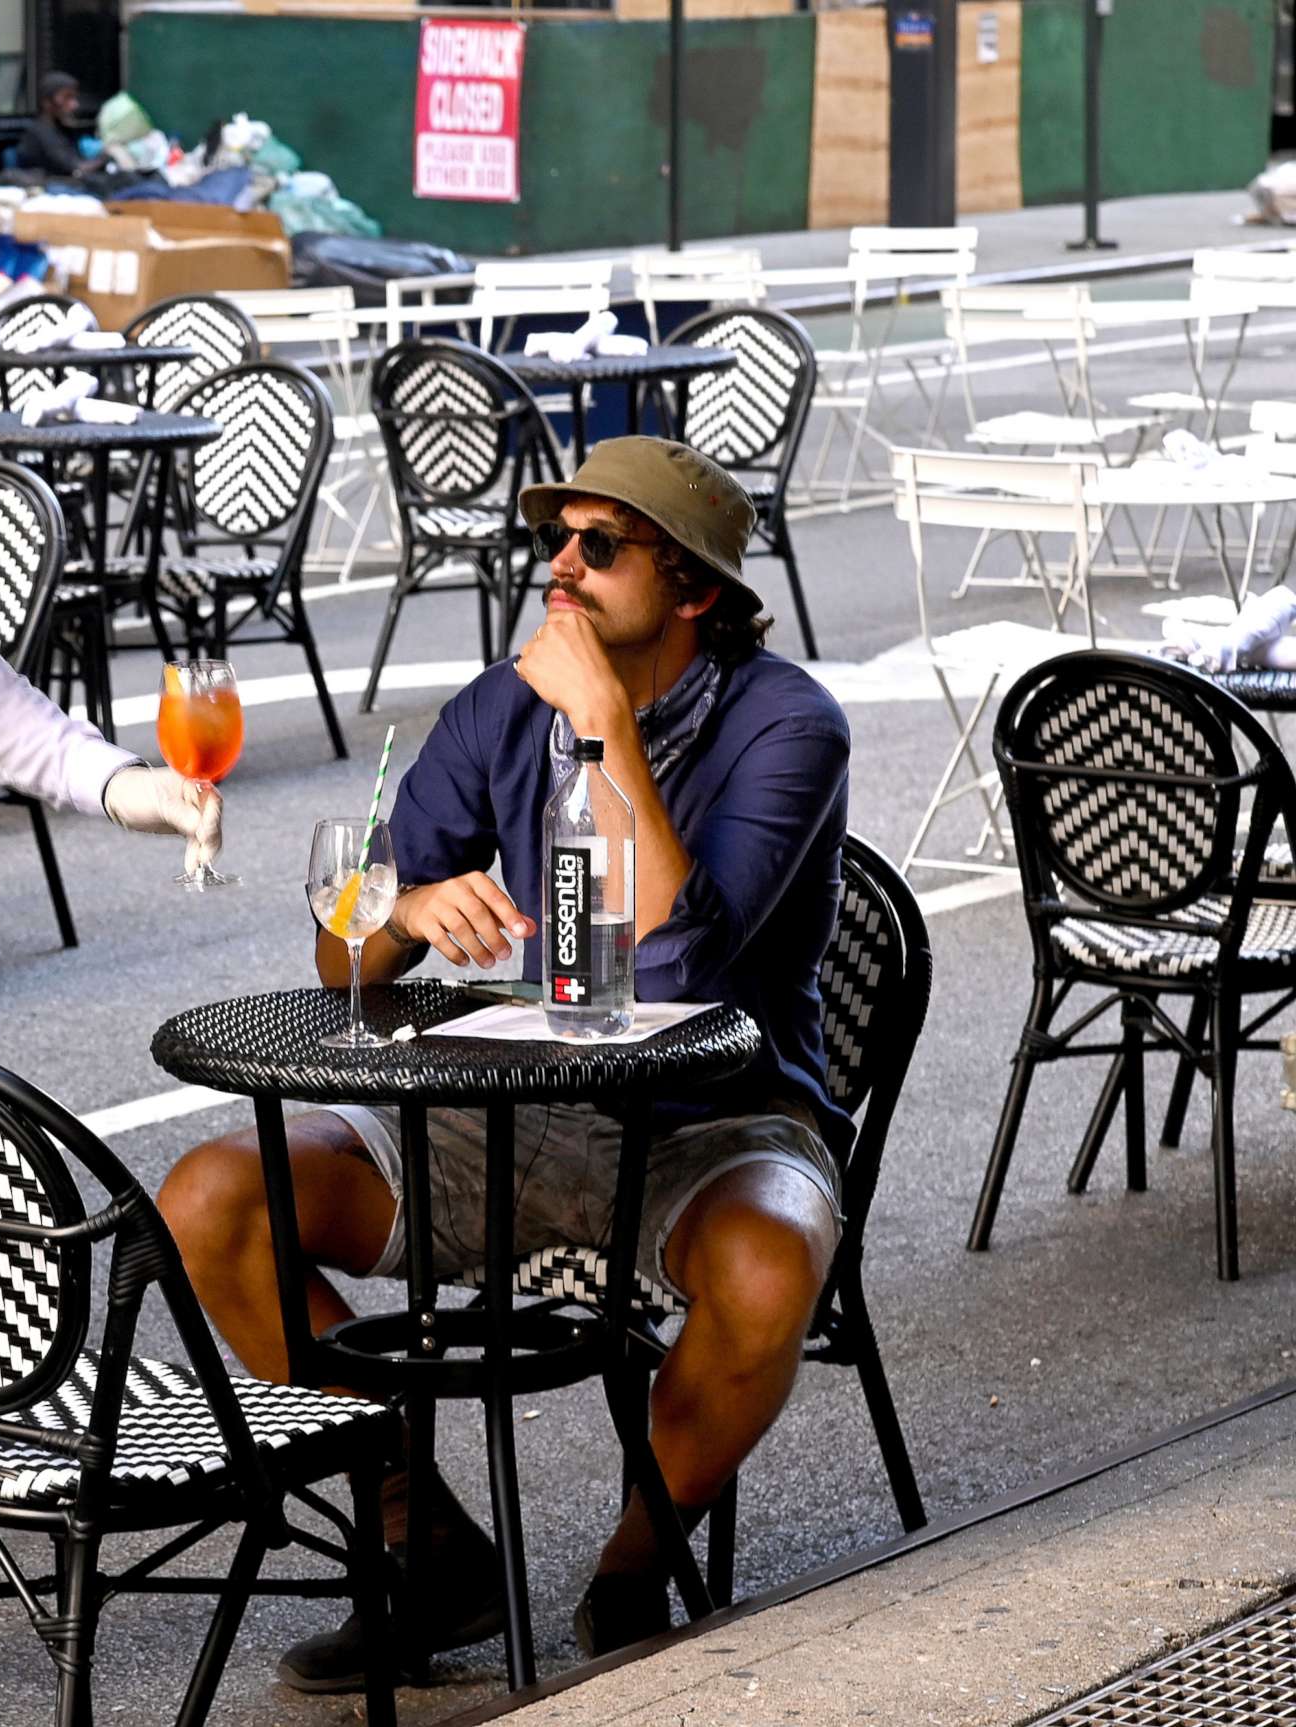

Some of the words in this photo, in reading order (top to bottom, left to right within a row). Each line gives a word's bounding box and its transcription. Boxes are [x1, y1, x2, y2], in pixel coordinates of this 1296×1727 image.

[422, 26, 523, 79] SIDEWALK
[430, 81, 504, 132] CLOSED
[555, 854, 577, 966] essentia
